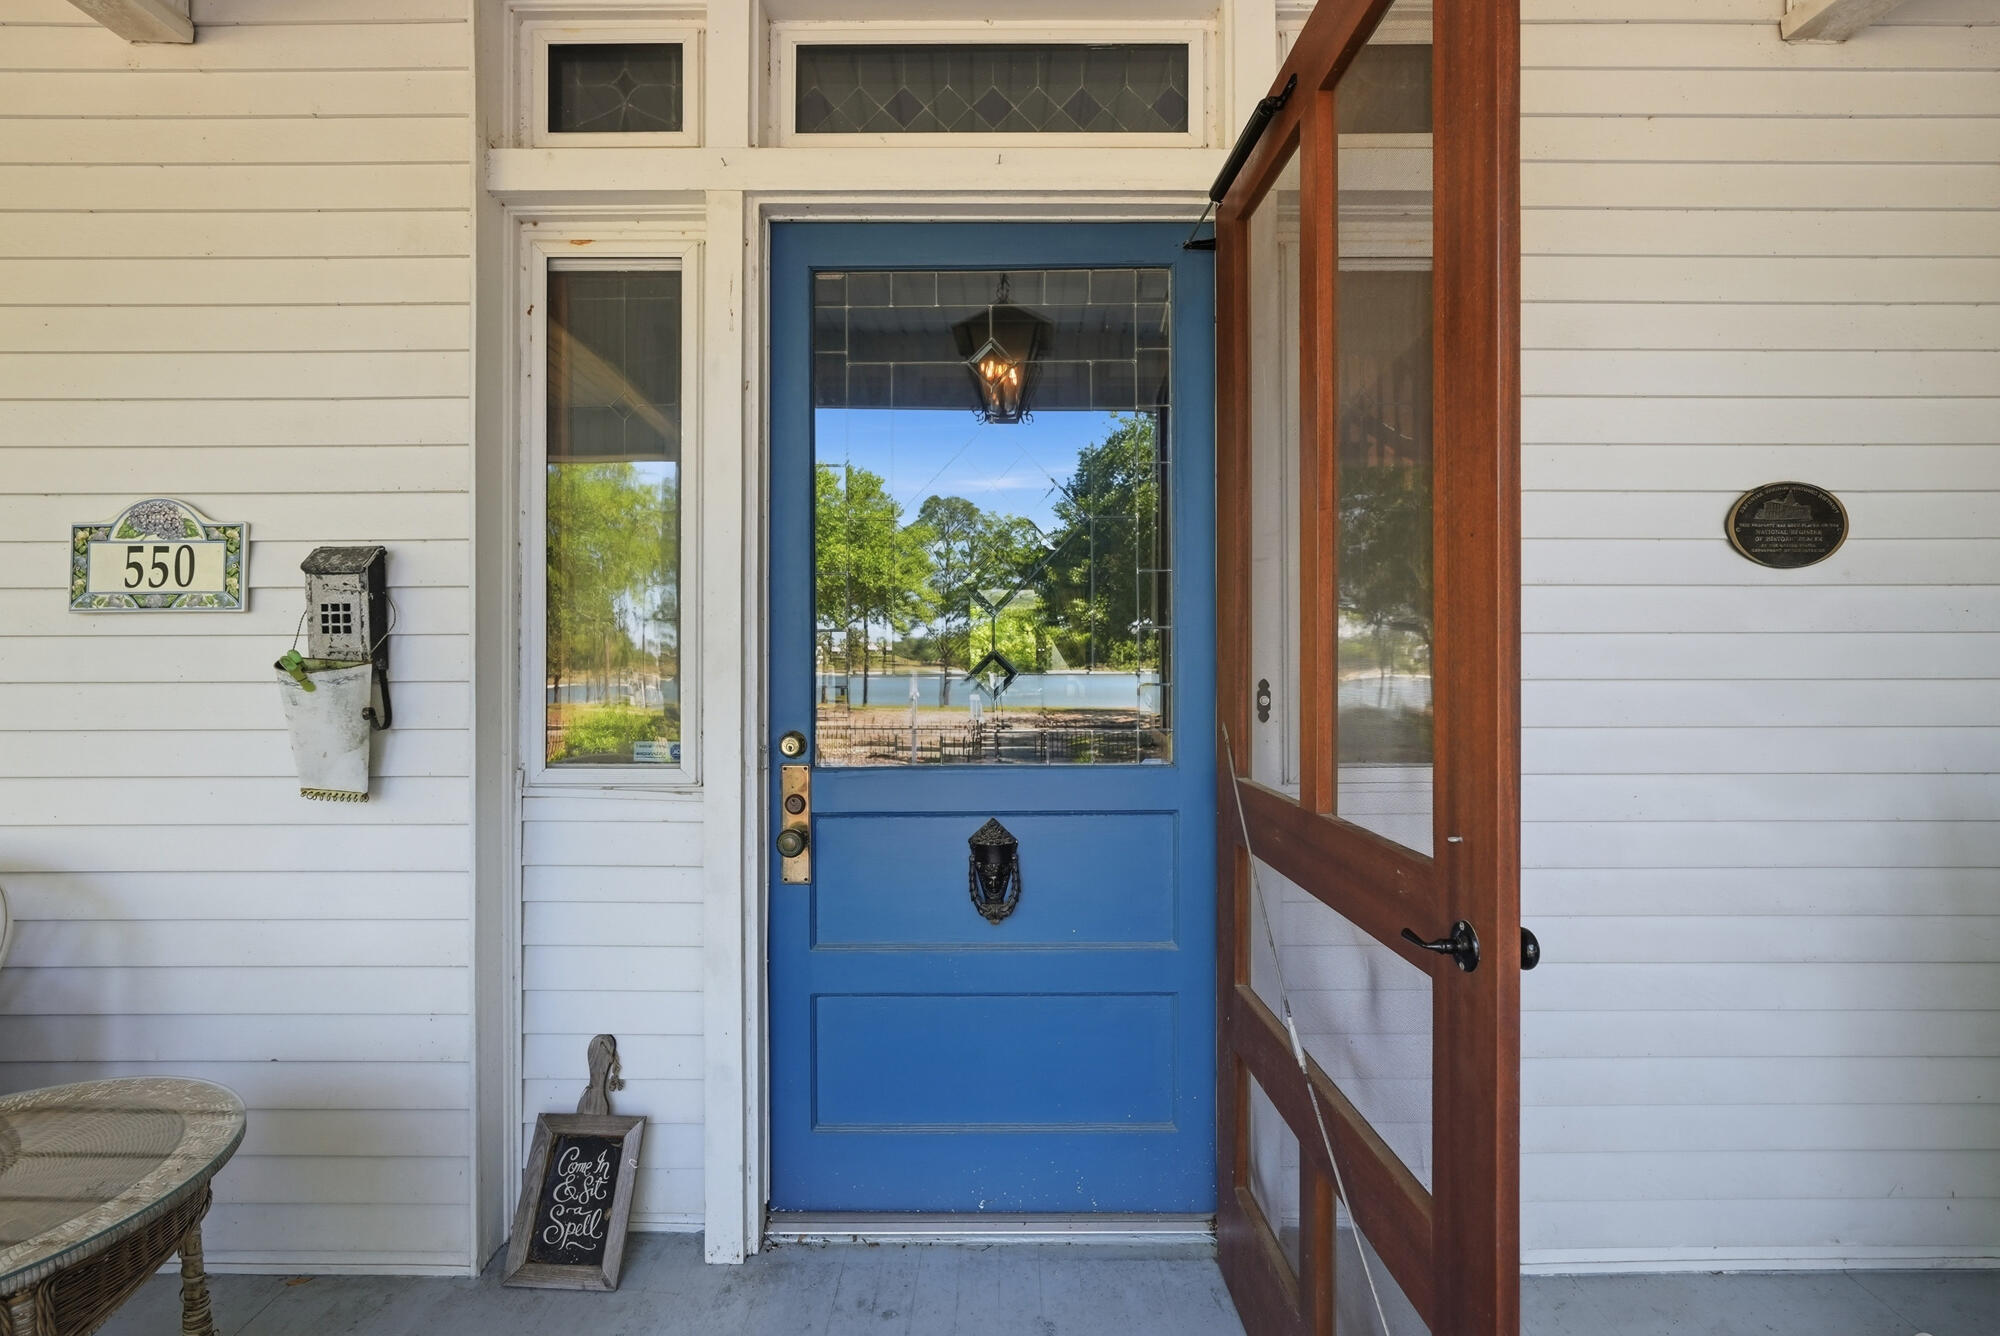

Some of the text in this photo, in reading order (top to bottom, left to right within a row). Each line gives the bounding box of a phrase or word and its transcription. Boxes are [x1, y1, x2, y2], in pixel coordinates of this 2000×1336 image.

[124, 544, 195, 588] 550
[558, 1146, 610, 1180] Come In
[553, 1174, 608, 1205] & Sit
[543, 1204, 603, 1250] Spell
